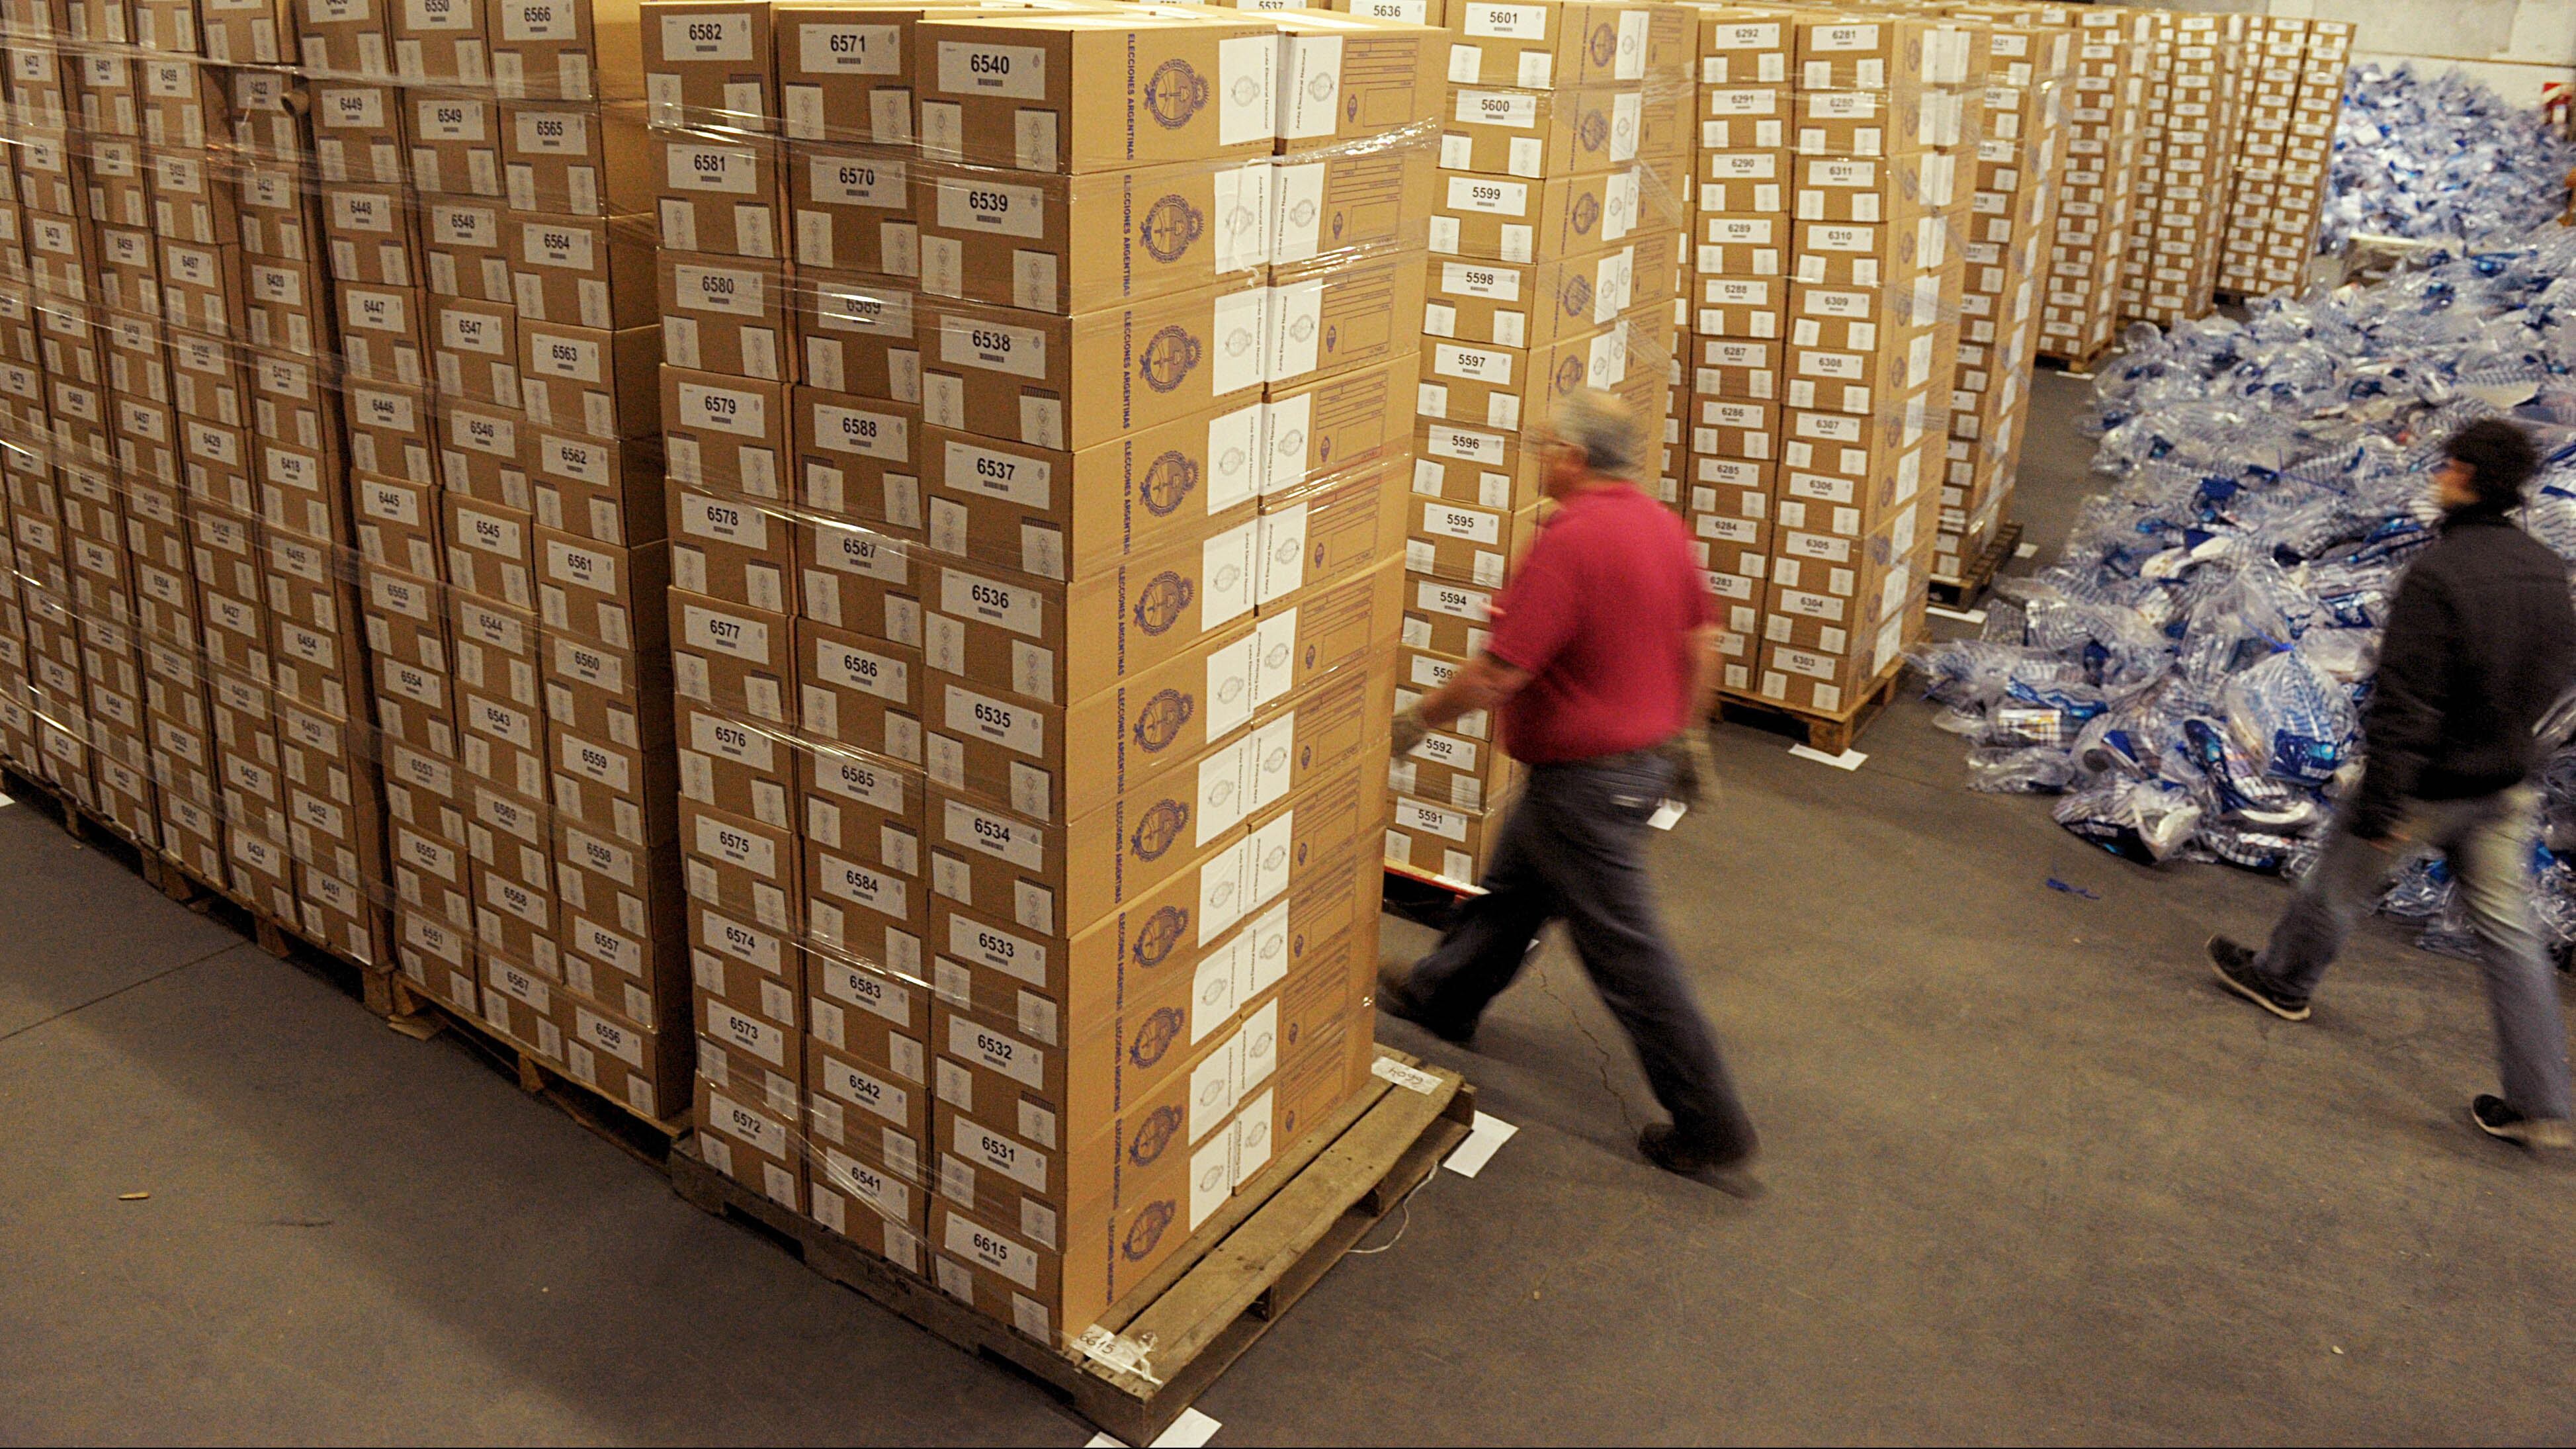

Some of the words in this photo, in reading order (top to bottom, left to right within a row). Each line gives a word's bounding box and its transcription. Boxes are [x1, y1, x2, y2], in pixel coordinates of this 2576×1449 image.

[425, 0, 449, 12] 6550
[525, 7, 550, 22] 6566
[1374, 5, 1400, 17] 5636
[1490, 12, 1517, 23] 5601
[689, 24, 722, 40] 6582
[1736, 29, 1758, 38] 6292
[1832, 30, 1856, 39] 6281
[831, 35, 865, 52] 6571
[971, 54, 1009, 74] 6540
[340, 97, 362, 110] 6449
[1482, 99, 1510, 112] 5600
[438, 109, 462, 122] 6549
[537, 121, 562, 136] 6565
[695, 155, 724, 171] 6581
[1732, 159, 1754, 167] 6290
[840, 167, 874, 185] 6570
[970, 191, 1008, 212] 6539
[1473, 187, 1500, 199] 5599
[351, 200, 371, 214] 6448
[452, 214, 474, 229] 6548
[544, 234, 570, 249] 6564
[1828, 231, 1852, 240] 6310
[703, 276, 734, 294] 6580
[1467, 272, 1493, 285] 5598
[365, 300, 384, 314] 6447
[1825, 296, 1848, 306] 6309
[460, 320, 482, 334] 6547
[972, 330, 1010, 351] 6538
[552, 345, 577, 361] 6563
[1724, 347, 1746, 355] 6287
[1459, 354, 1485, 367] 5597
[1819, 358, 1842, 367] 6308
[373, 400, 394, 414] 6446
[705, 396, 736, 414] 6579
[1722, 408, 1743, 417] 6286
[470, 421, 494, 437] 6546
[843, 417, 877, 437] 6588
[1817, 419, 1839, 429] 6307
[1453, 435, 1479, 449] 5596
[562, 447, 586, 464] 6562
[977, 458, 1015, 480] 6537
[1717, 465, 1739, 476] 6285
[1810, 480, 1832, 490] 6306
[379, 492, 399, 507] 6445
[707, 507, 738, 525] 6578
[1447, 514, 1473, 527] 5595
[477, 521, 499, 538] 6545
[1715, 521, 1737, 531] 6284
[844, 539, 875, 558] 6587
[1806, 539, 1829, 549] 6305
[568, 554, 591, 572] 6561
[1709, 576, 1731, 587] 6283
[972, 585, 1008, 608] 6536
[1441, 592, 1466, 605] 5594
[1801, 597, 1823, 607] 6304
[480, 615, 503, 632] 6544
[710, 620, 740, 638] 6577
[575, 652, 599, 670] 6560
[845, 655, 877, 677] 6586
[1793, 655, 1815, 668] 6303
[401, 671, 422, 687] 6554
[488, 708, 510, 727] 6543
[975, 704, 1010, 728] 6535
[716, 726, 746, 747] 6576
[1426, 738, 1452, 755] 5592
[583, 749, 607, 769] 6559
[842, 765, 874, 787] 6585
[1419, 809, 1442, 824] 5591
[975, 818, 1009, 843] 6534
[720, 832, 749, 852] 6575
[416, 842, 437, 860] 6552
[587, 843, 611, 863] 6558
[847, 871, 878, 894] 6584
[504, 887, 527, 906] 6568
[423, 926, 442, 945] 6551
[595, 932, 619, 953] 6557
[726, 927, 755, 949] 6574
[979, 933, 1013, 958] 6533
[507, 972, 529, 991] 6567
[850, 975, 881, 999] 6583
[596, 1022, 621, 1043] 6556
[730, 1016, 758, 1039] 6573
[978, 1034, 1012, 1061] 6532
[849, 1075, 880, 1099] 6542
[733, 1110, 761, 1133] 6572
[982, 1136, 1015, 1163] 6531
[852, 1166, 881, 1192] 6541
[974, 1233, 1008, 1260] 6615
[1080, 1331, 1115, 1354] 6615
